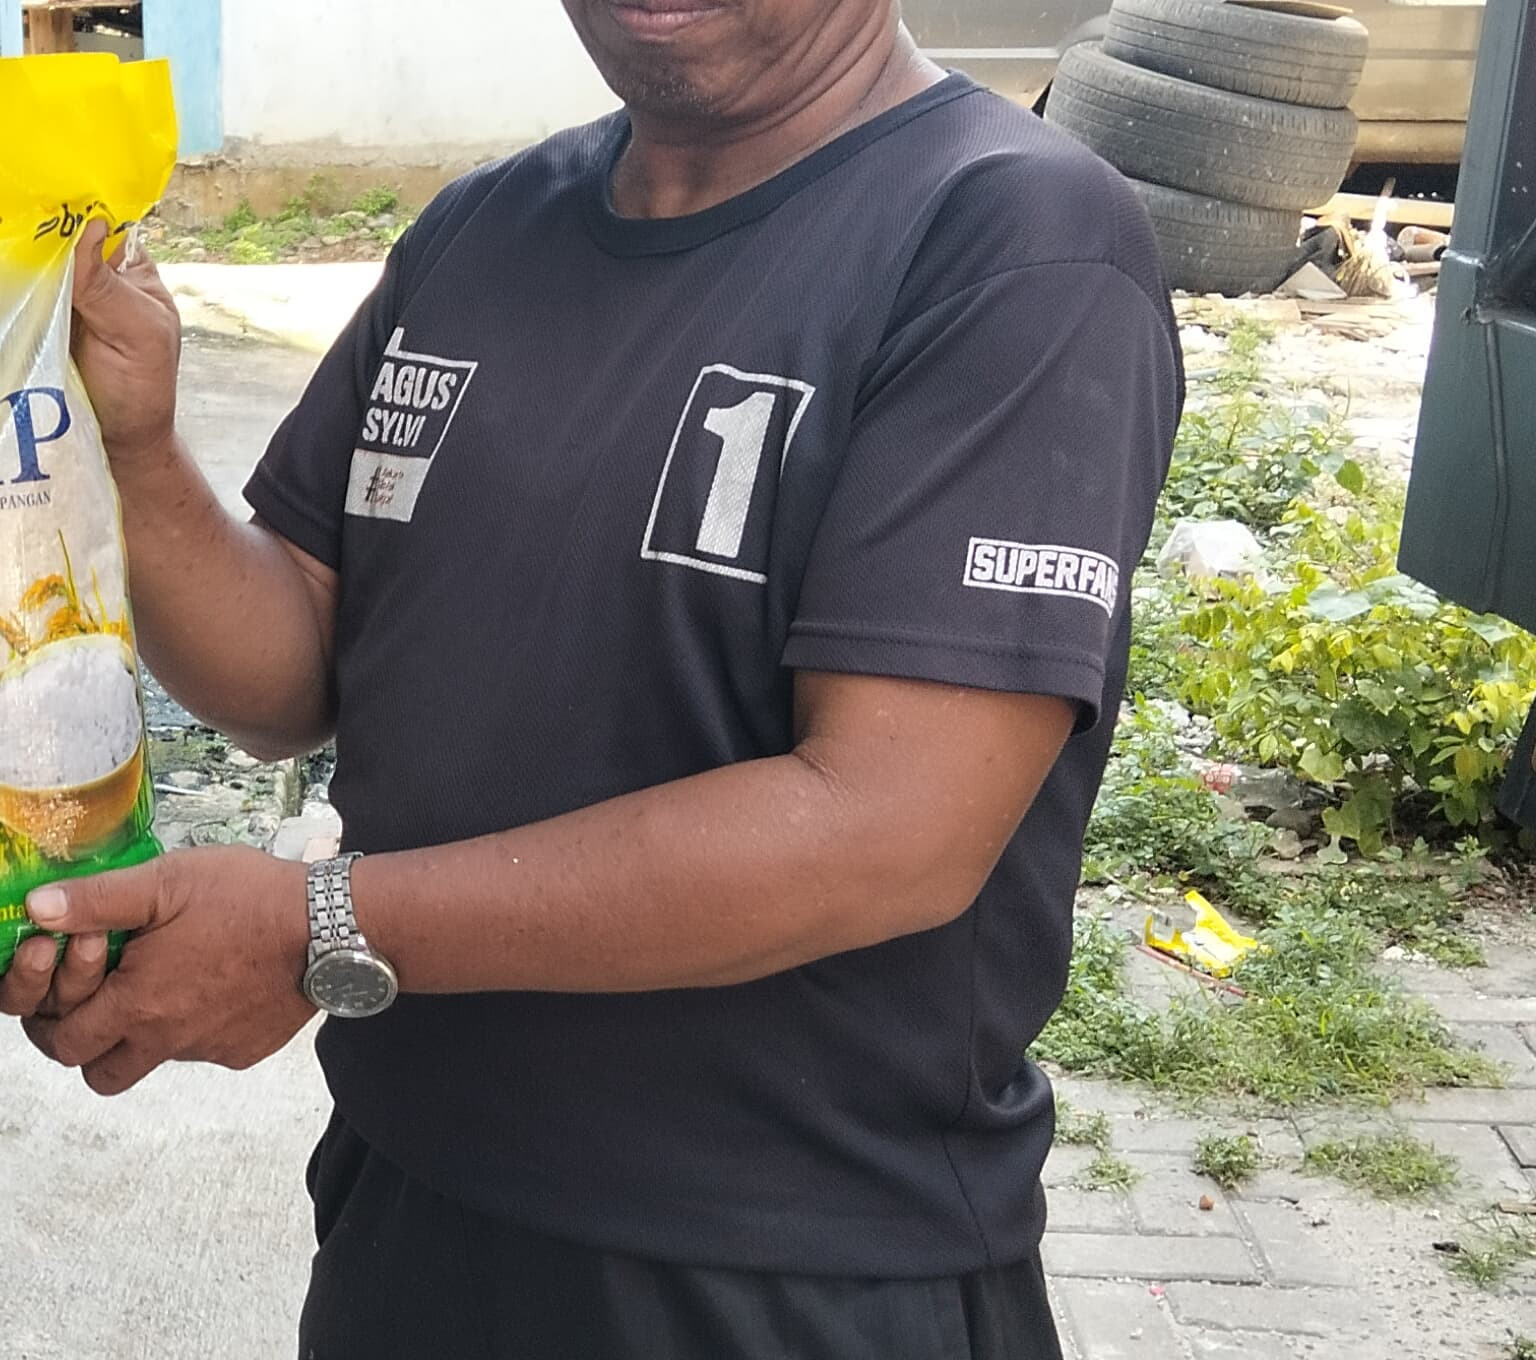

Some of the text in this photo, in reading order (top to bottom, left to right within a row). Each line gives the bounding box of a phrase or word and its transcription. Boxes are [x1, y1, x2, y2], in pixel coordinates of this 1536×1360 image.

[370, 362, 457, 410] AGUS
[696, 392, 775, 558] 1
[0, 490, 52, 511] PANGAN
